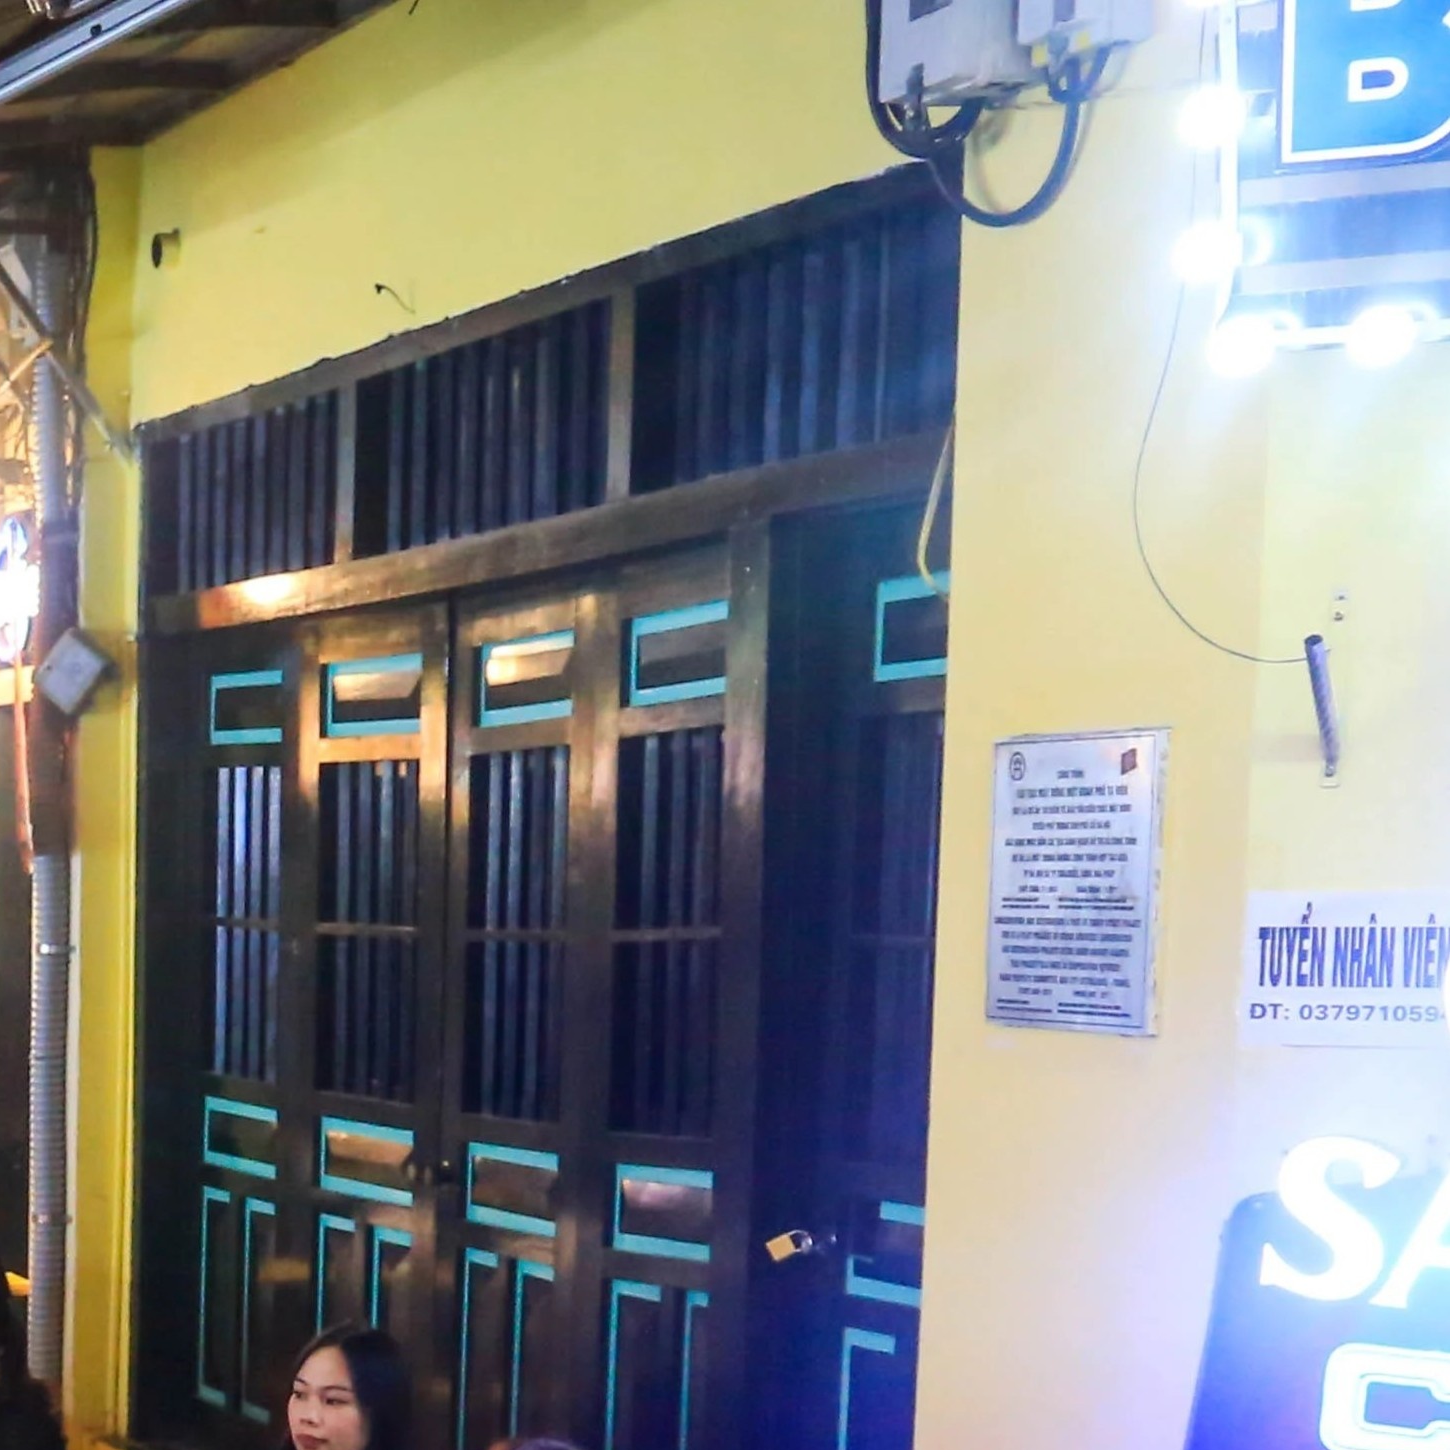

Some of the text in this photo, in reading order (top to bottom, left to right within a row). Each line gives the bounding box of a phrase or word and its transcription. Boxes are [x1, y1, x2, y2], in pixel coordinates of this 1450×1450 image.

[1258, 901, 1327, 987] TUYỂN
[1332, 913, 1396, 988] NHÂN
[1299, 1004, 1445, 1022] 037971059
